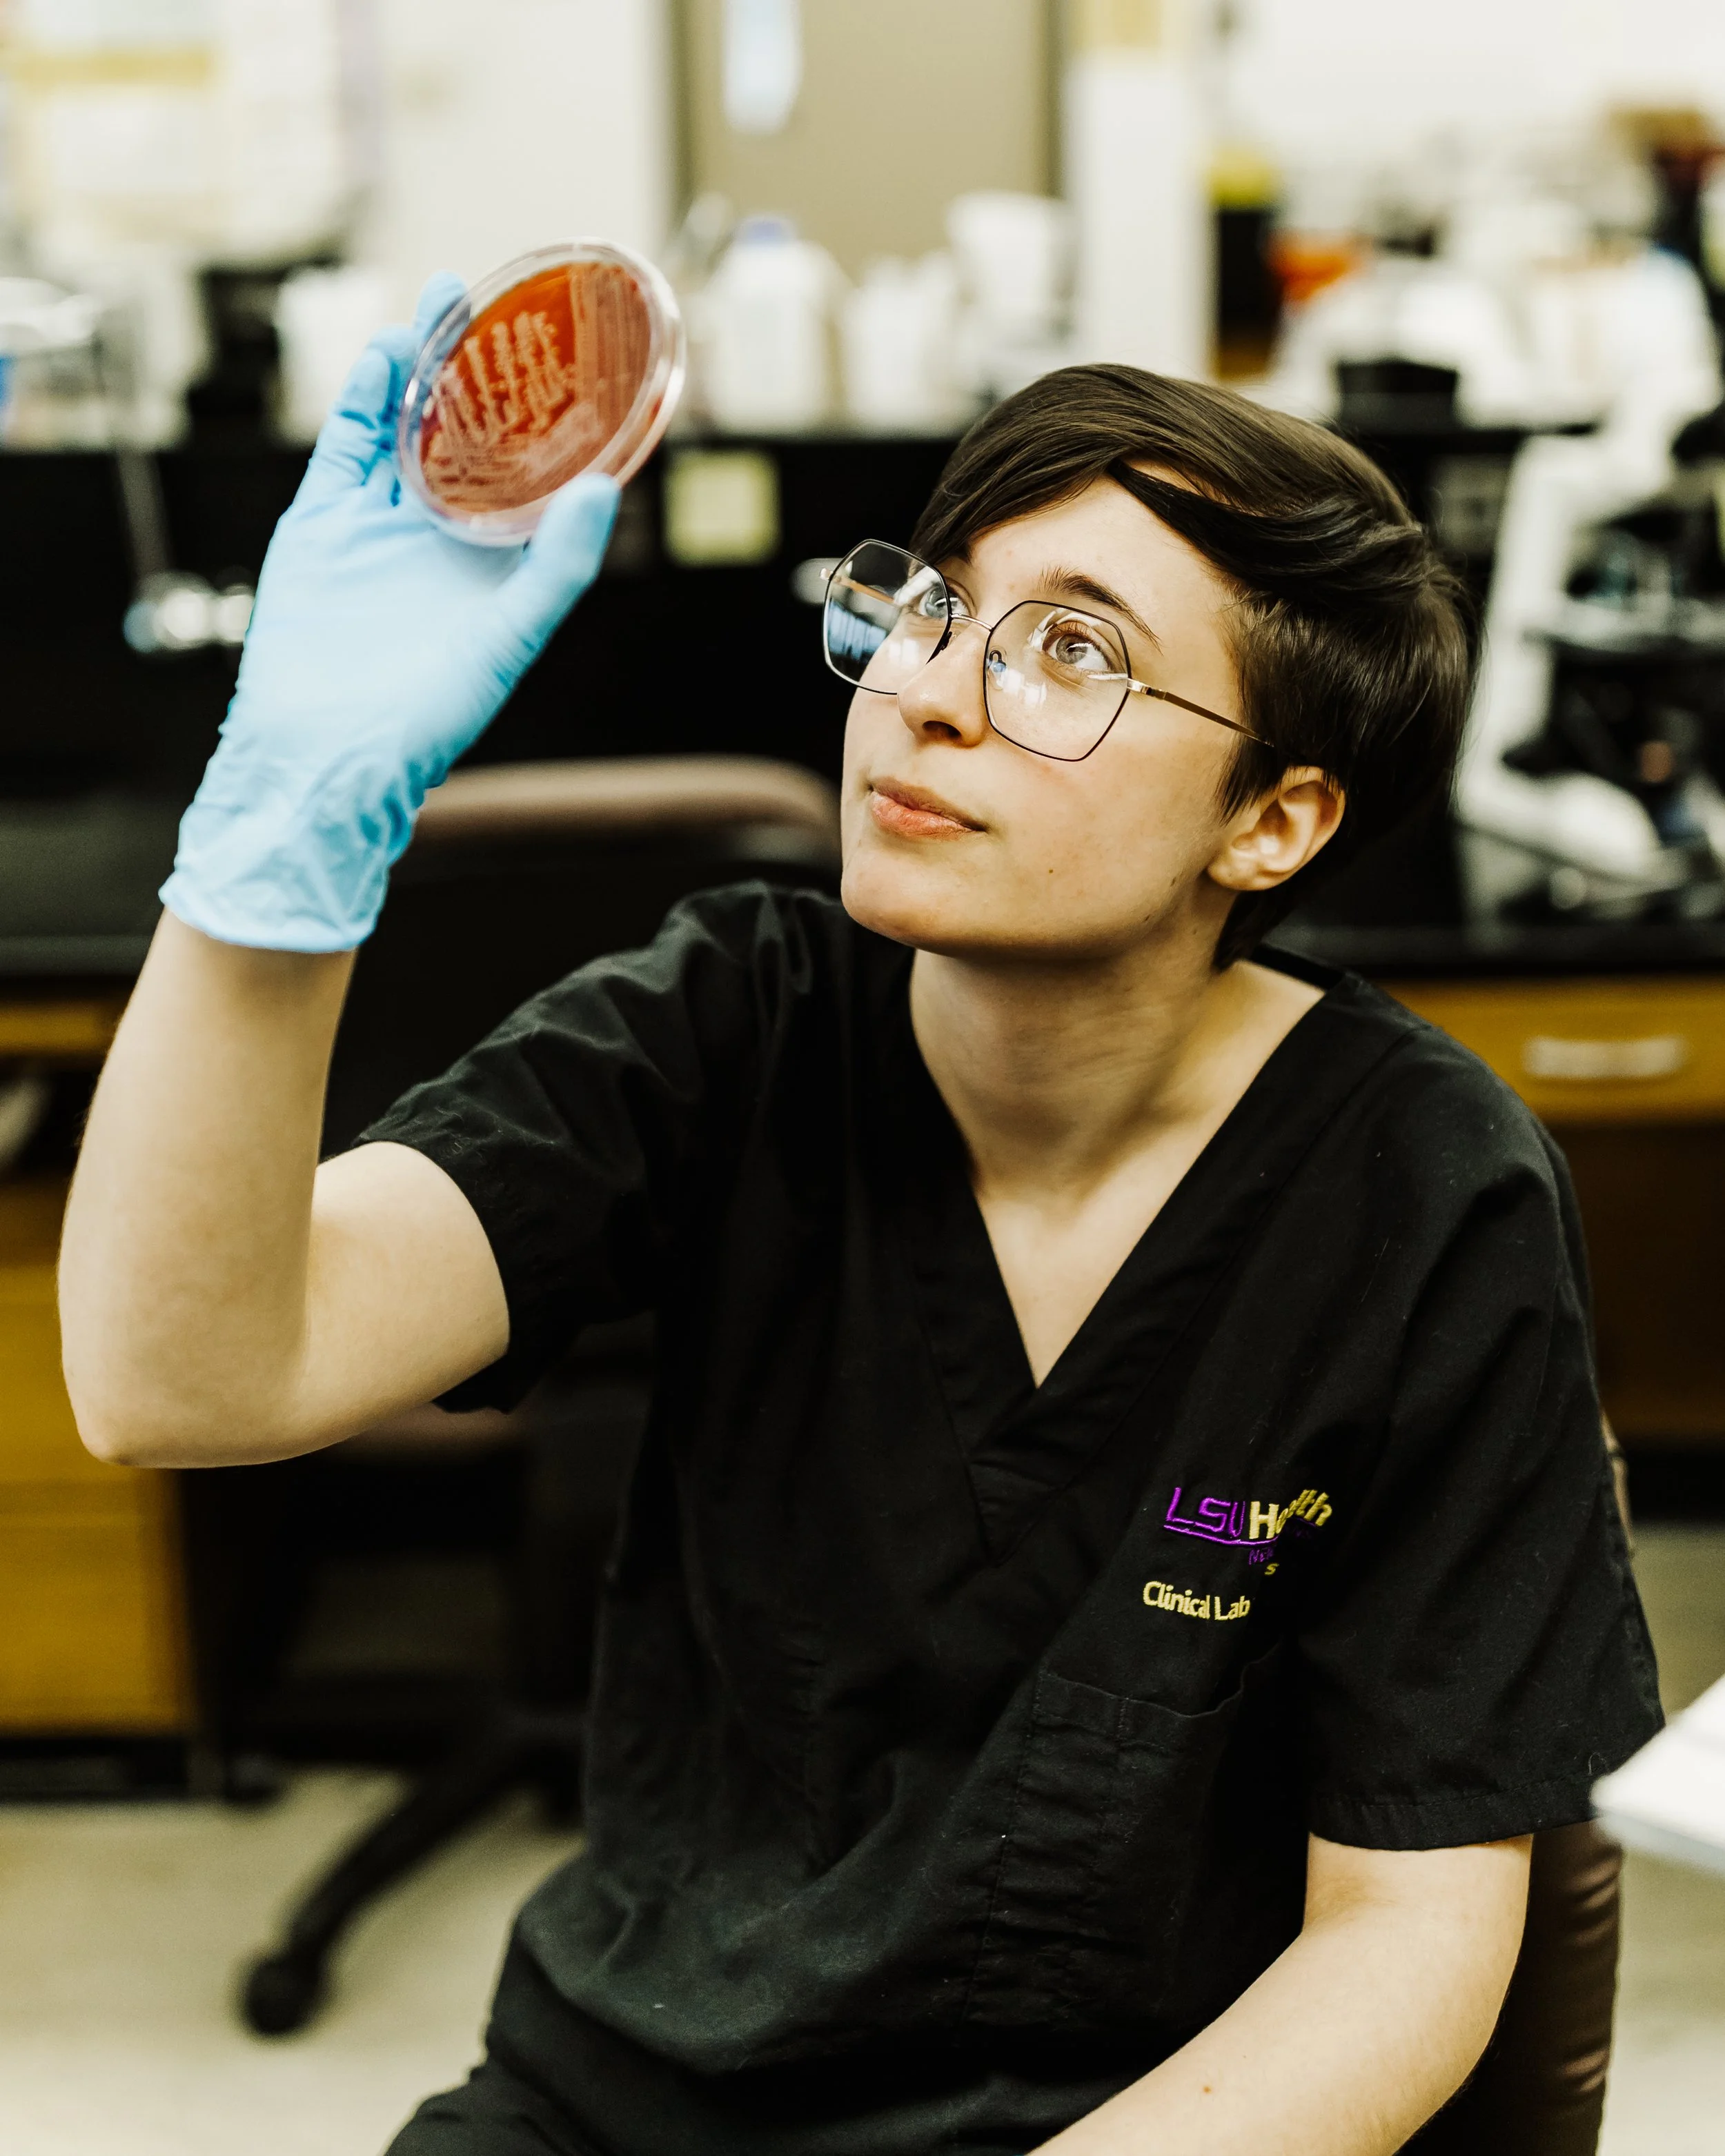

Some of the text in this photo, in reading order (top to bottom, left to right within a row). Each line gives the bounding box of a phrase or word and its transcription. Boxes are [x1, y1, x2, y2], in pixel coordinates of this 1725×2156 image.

[1165, 1487, 1246, 1538] LSU
[1143, 1581, 1251, 1621] Clinical Lab
